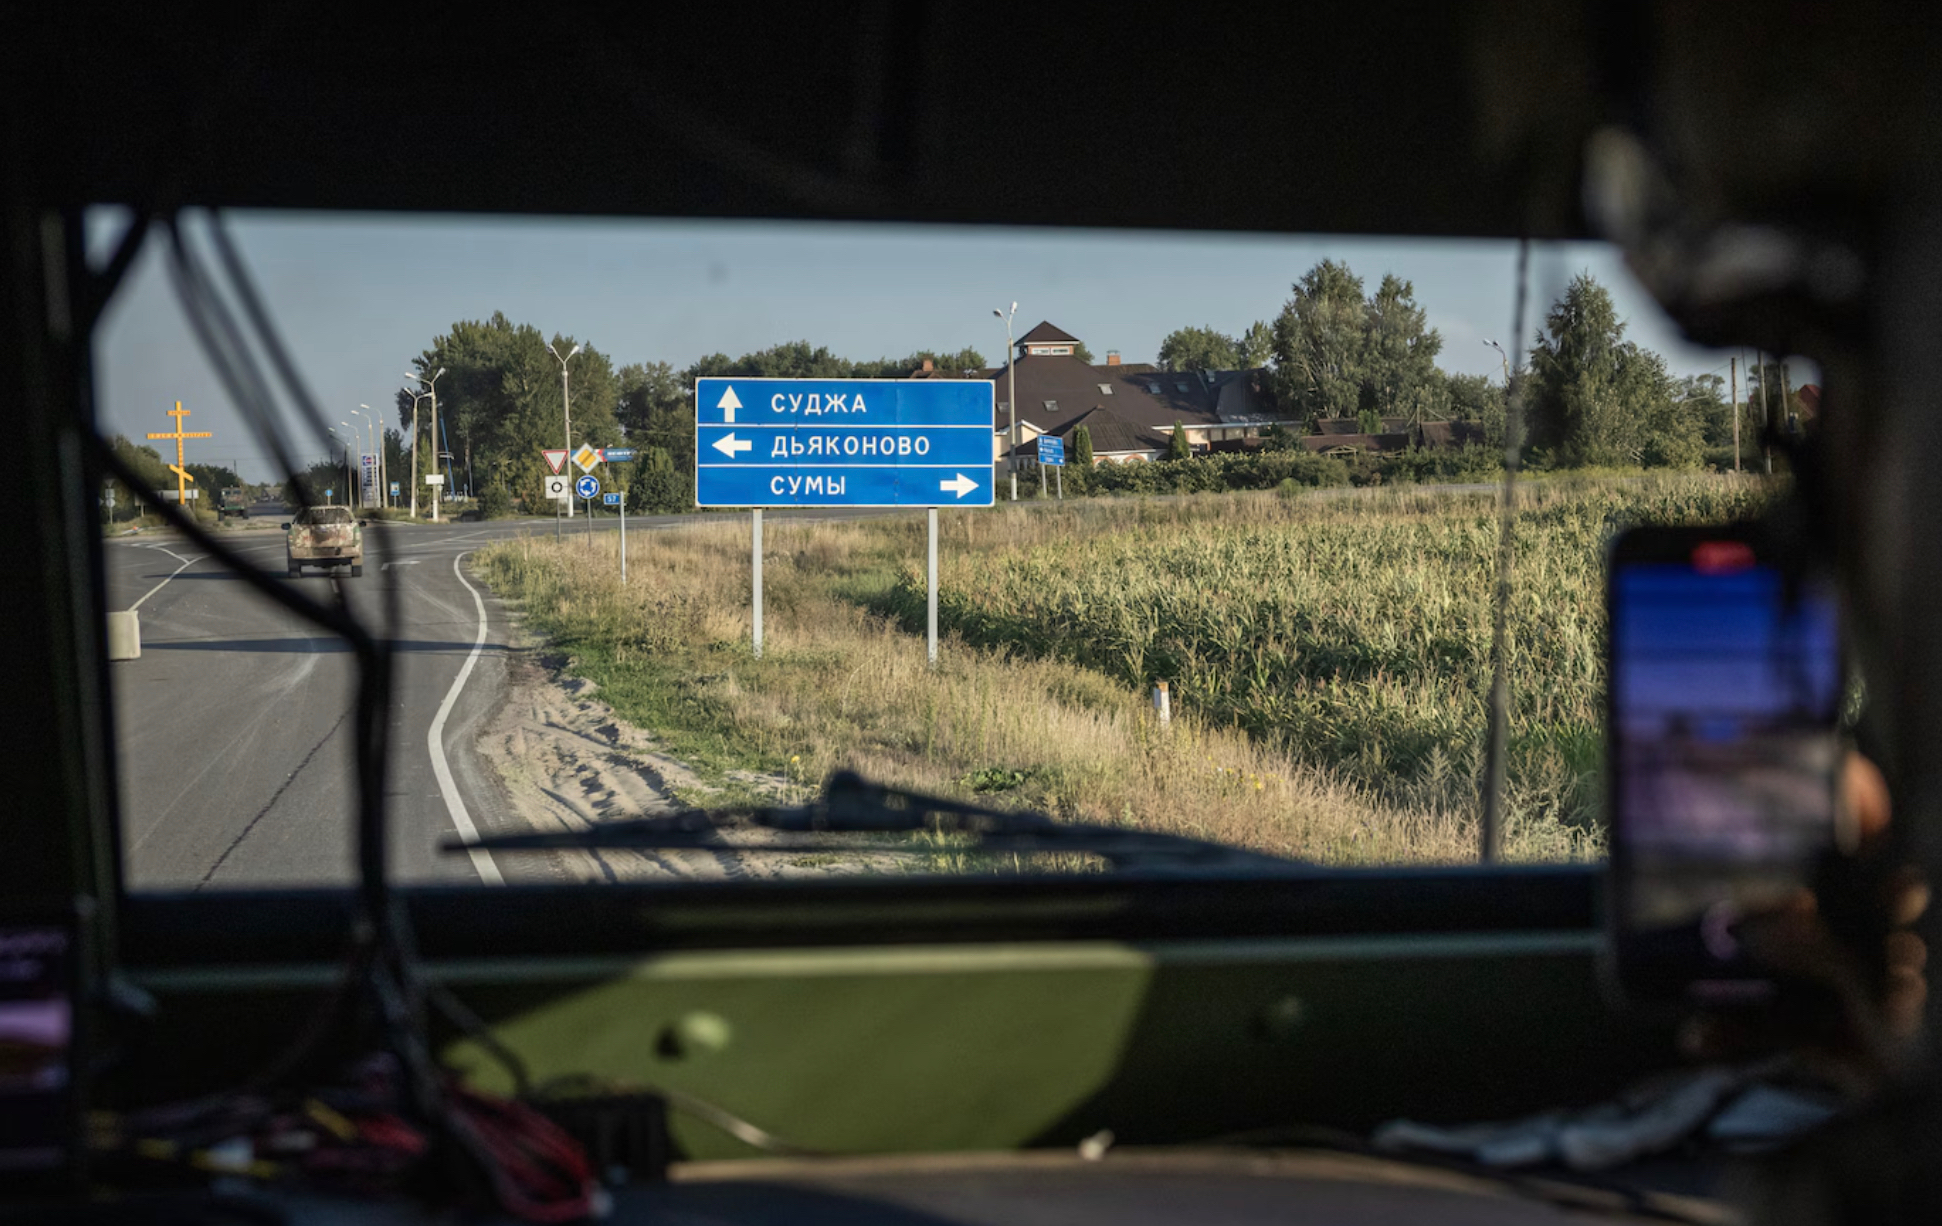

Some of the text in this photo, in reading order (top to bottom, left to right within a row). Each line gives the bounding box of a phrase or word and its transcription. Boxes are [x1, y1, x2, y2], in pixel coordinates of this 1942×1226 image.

[771, 393, 867, 416] СУДЖА
[771, 435, 930, 458] ДЬЯКОНОВО
[771, 475, 846, 495] СУМЫ
